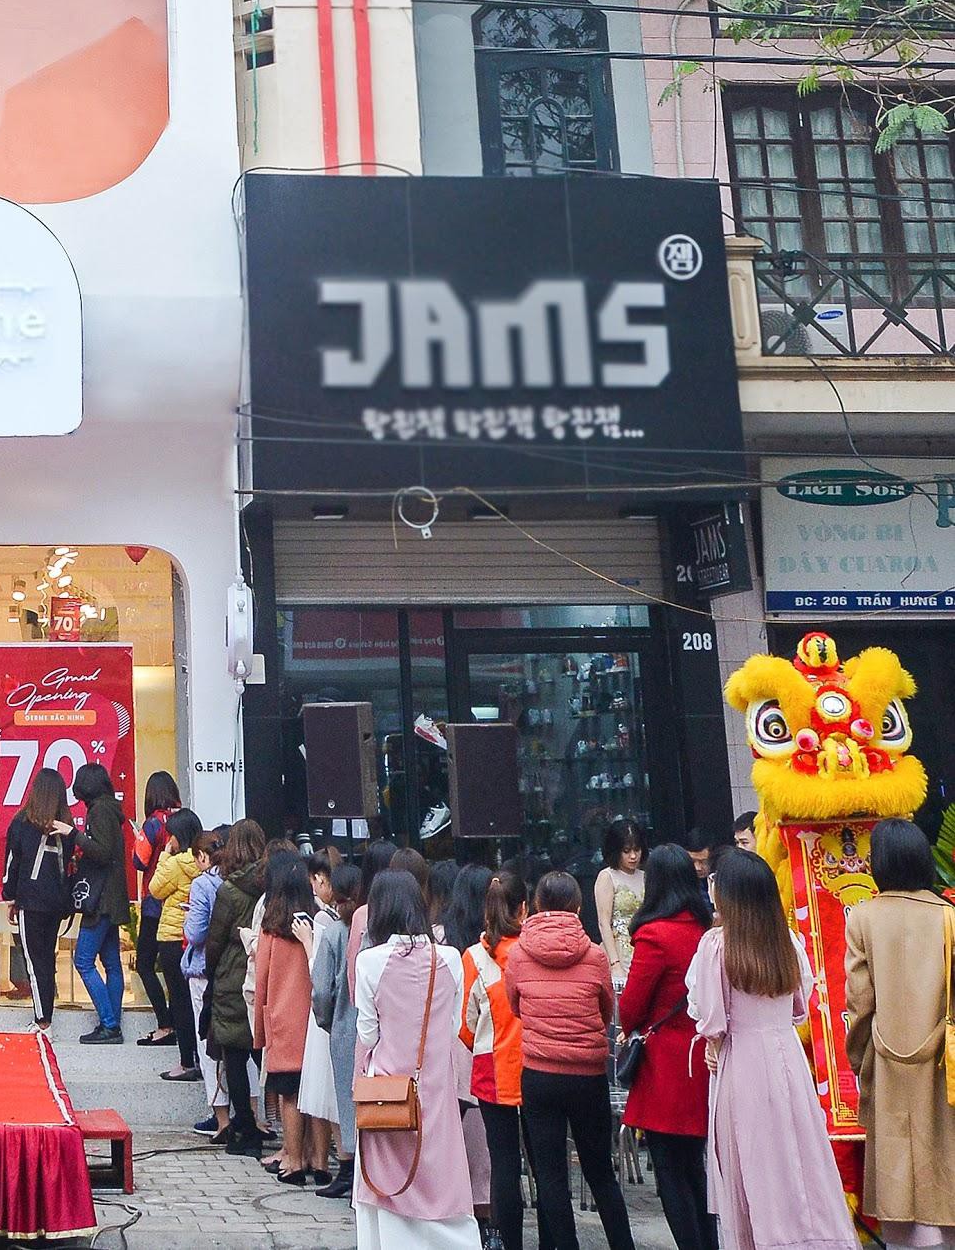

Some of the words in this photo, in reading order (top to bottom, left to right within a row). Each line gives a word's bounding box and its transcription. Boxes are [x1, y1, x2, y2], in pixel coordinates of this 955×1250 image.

[875, 524, 904, 542] BI
[694, 521, 726, 566] JAMS
[823, 596, 848, 606] 206
[900, 595, 938, 606] HƯNG
[683, 633, 712, 650] 208
[42, 667, 102, 690] Grand
[6, 683, 92, 716] Opening
